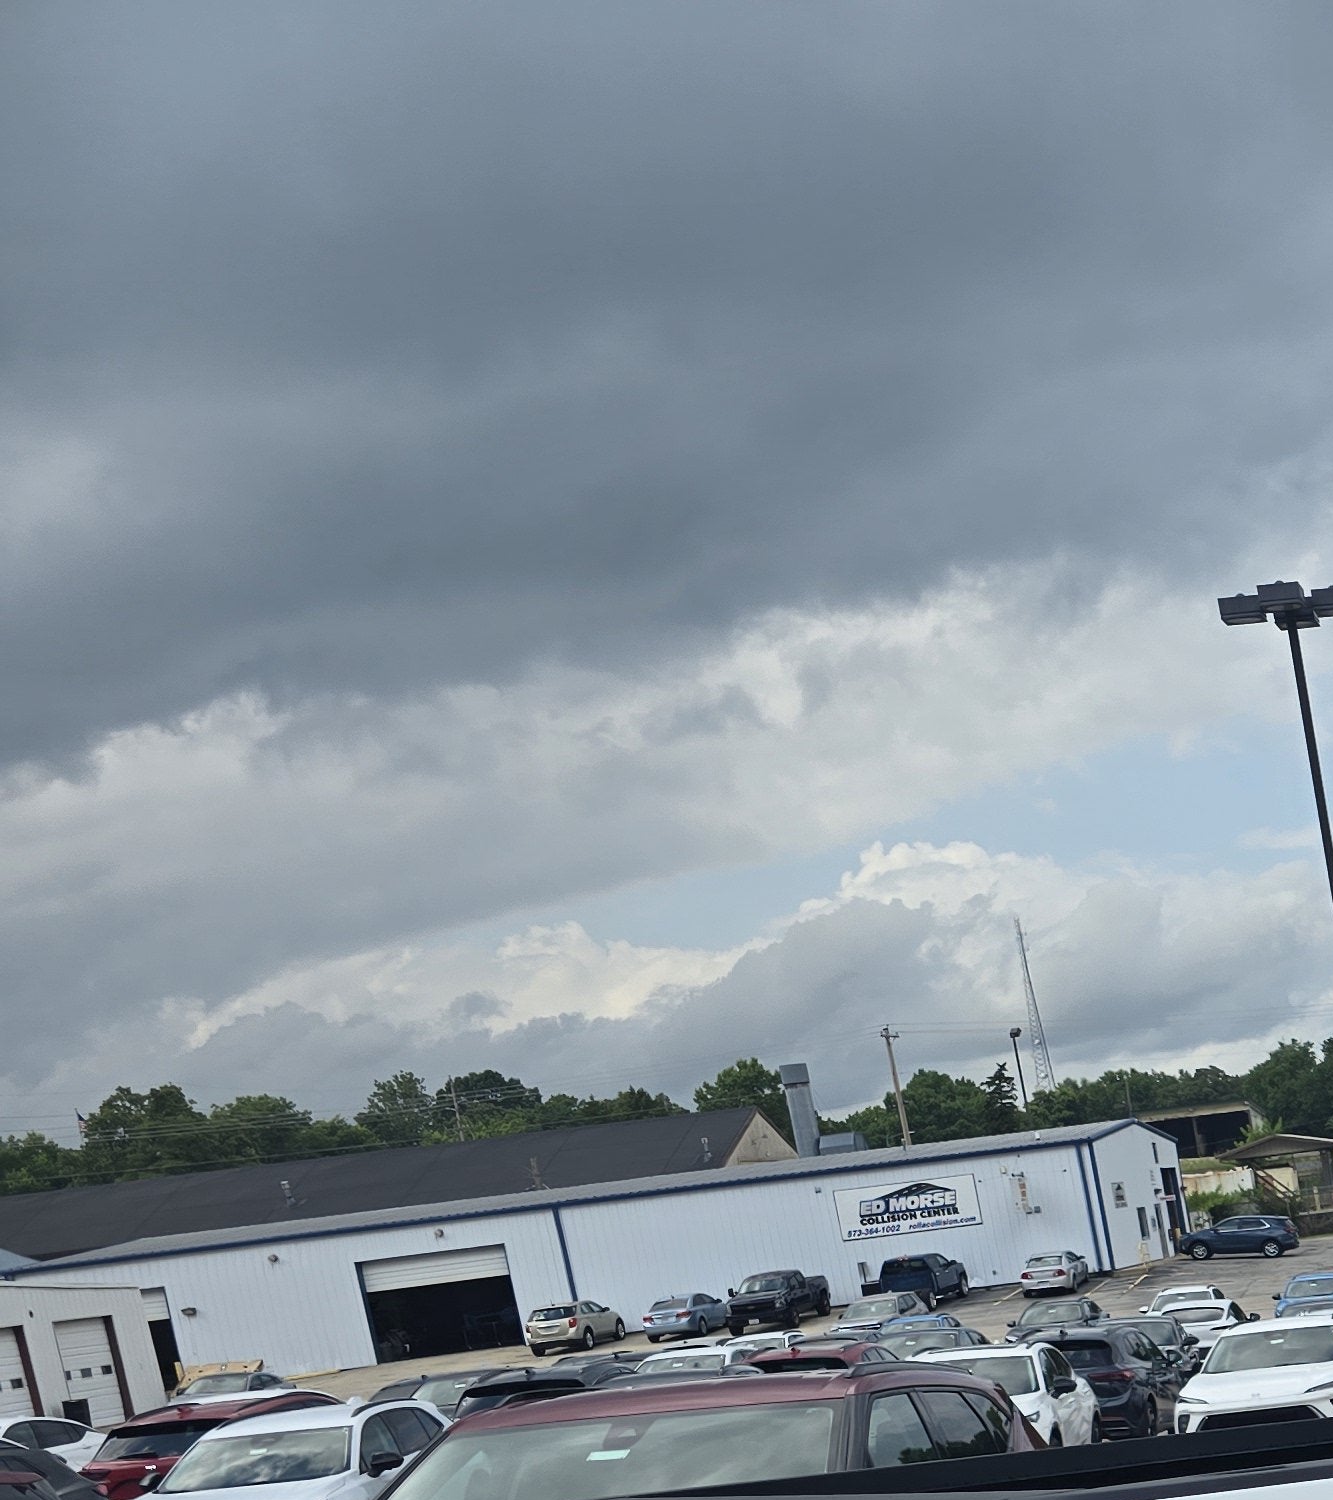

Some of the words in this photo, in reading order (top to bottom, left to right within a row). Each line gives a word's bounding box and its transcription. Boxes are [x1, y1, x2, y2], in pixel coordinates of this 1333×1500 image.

[860, 1201, 886, 1215] ED
[889, 1189, 957, 1214] MORSE
[860, 1212, 917, 1226] COLLISION
[920, 1206, 960, 1219] CENTER
[848, 1224, 901, 1238] 573-364-1002
